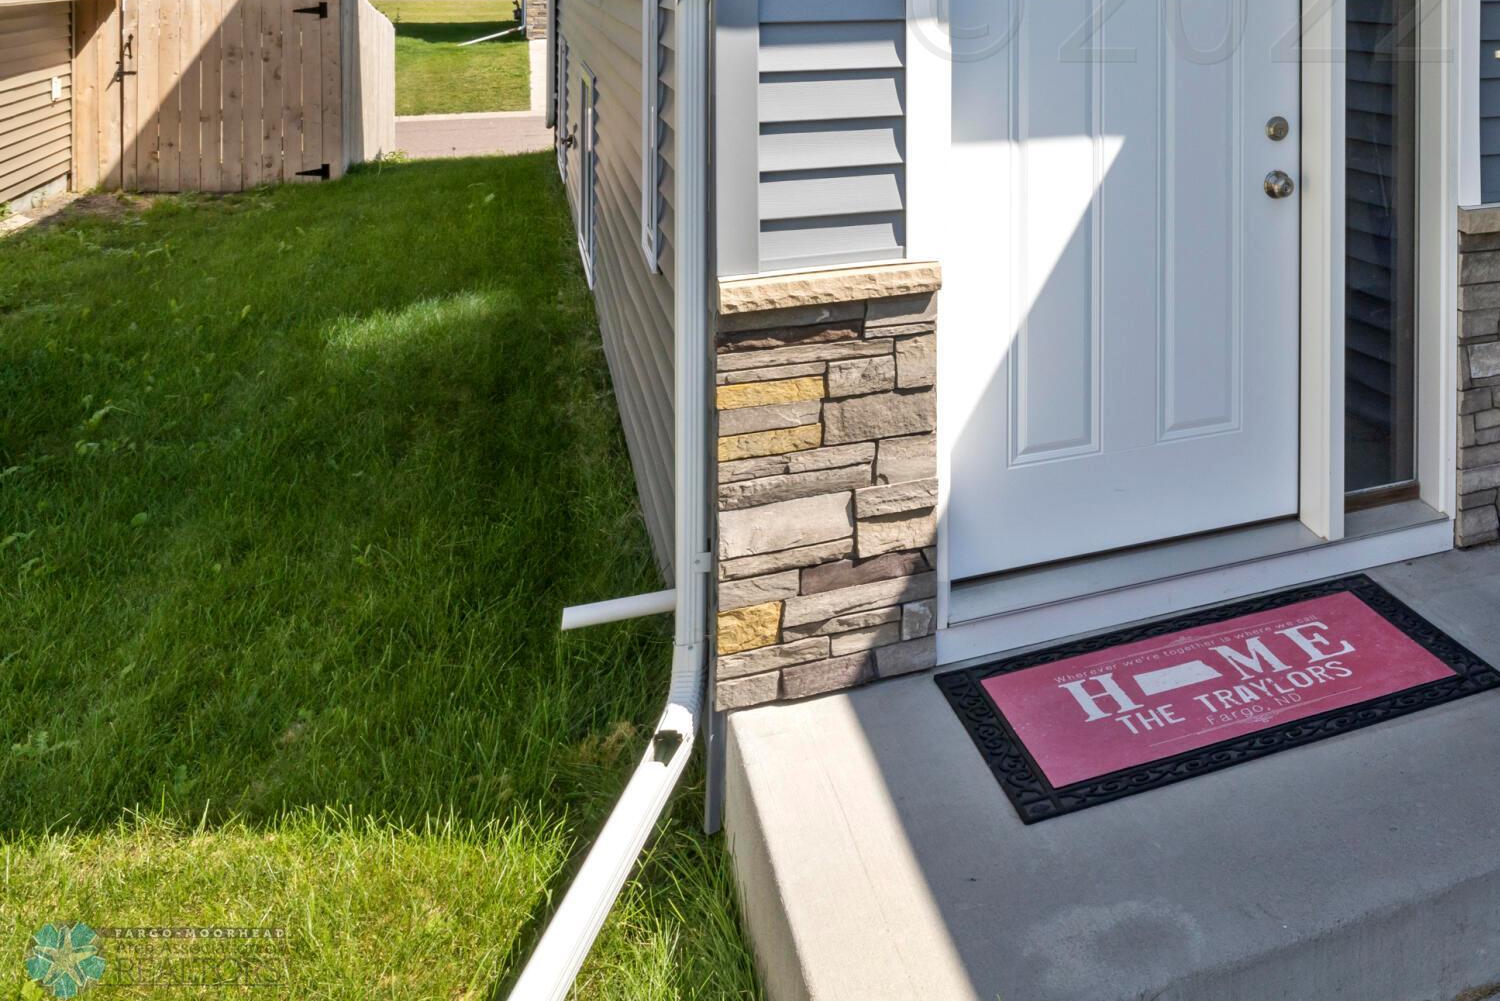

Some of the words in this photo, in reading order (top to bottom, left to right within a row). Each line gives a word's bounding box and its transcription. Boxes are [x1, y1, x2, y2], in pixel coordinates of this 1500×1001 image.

[1053, 663, 1117, 683] Wherever
[1122, 654, 1160, 667] we're
[1163, 638, 1216, 657] together
[1219, 635, 1231, 643] is
[1234, 627, 1272, 639] where
[1274, 621, 1294, 629] we
[1115, 703, 1186, 734] THE
[1193, 660, 1353, 713] TRAYLORS
[1275, 692, 1302, 707] ND
